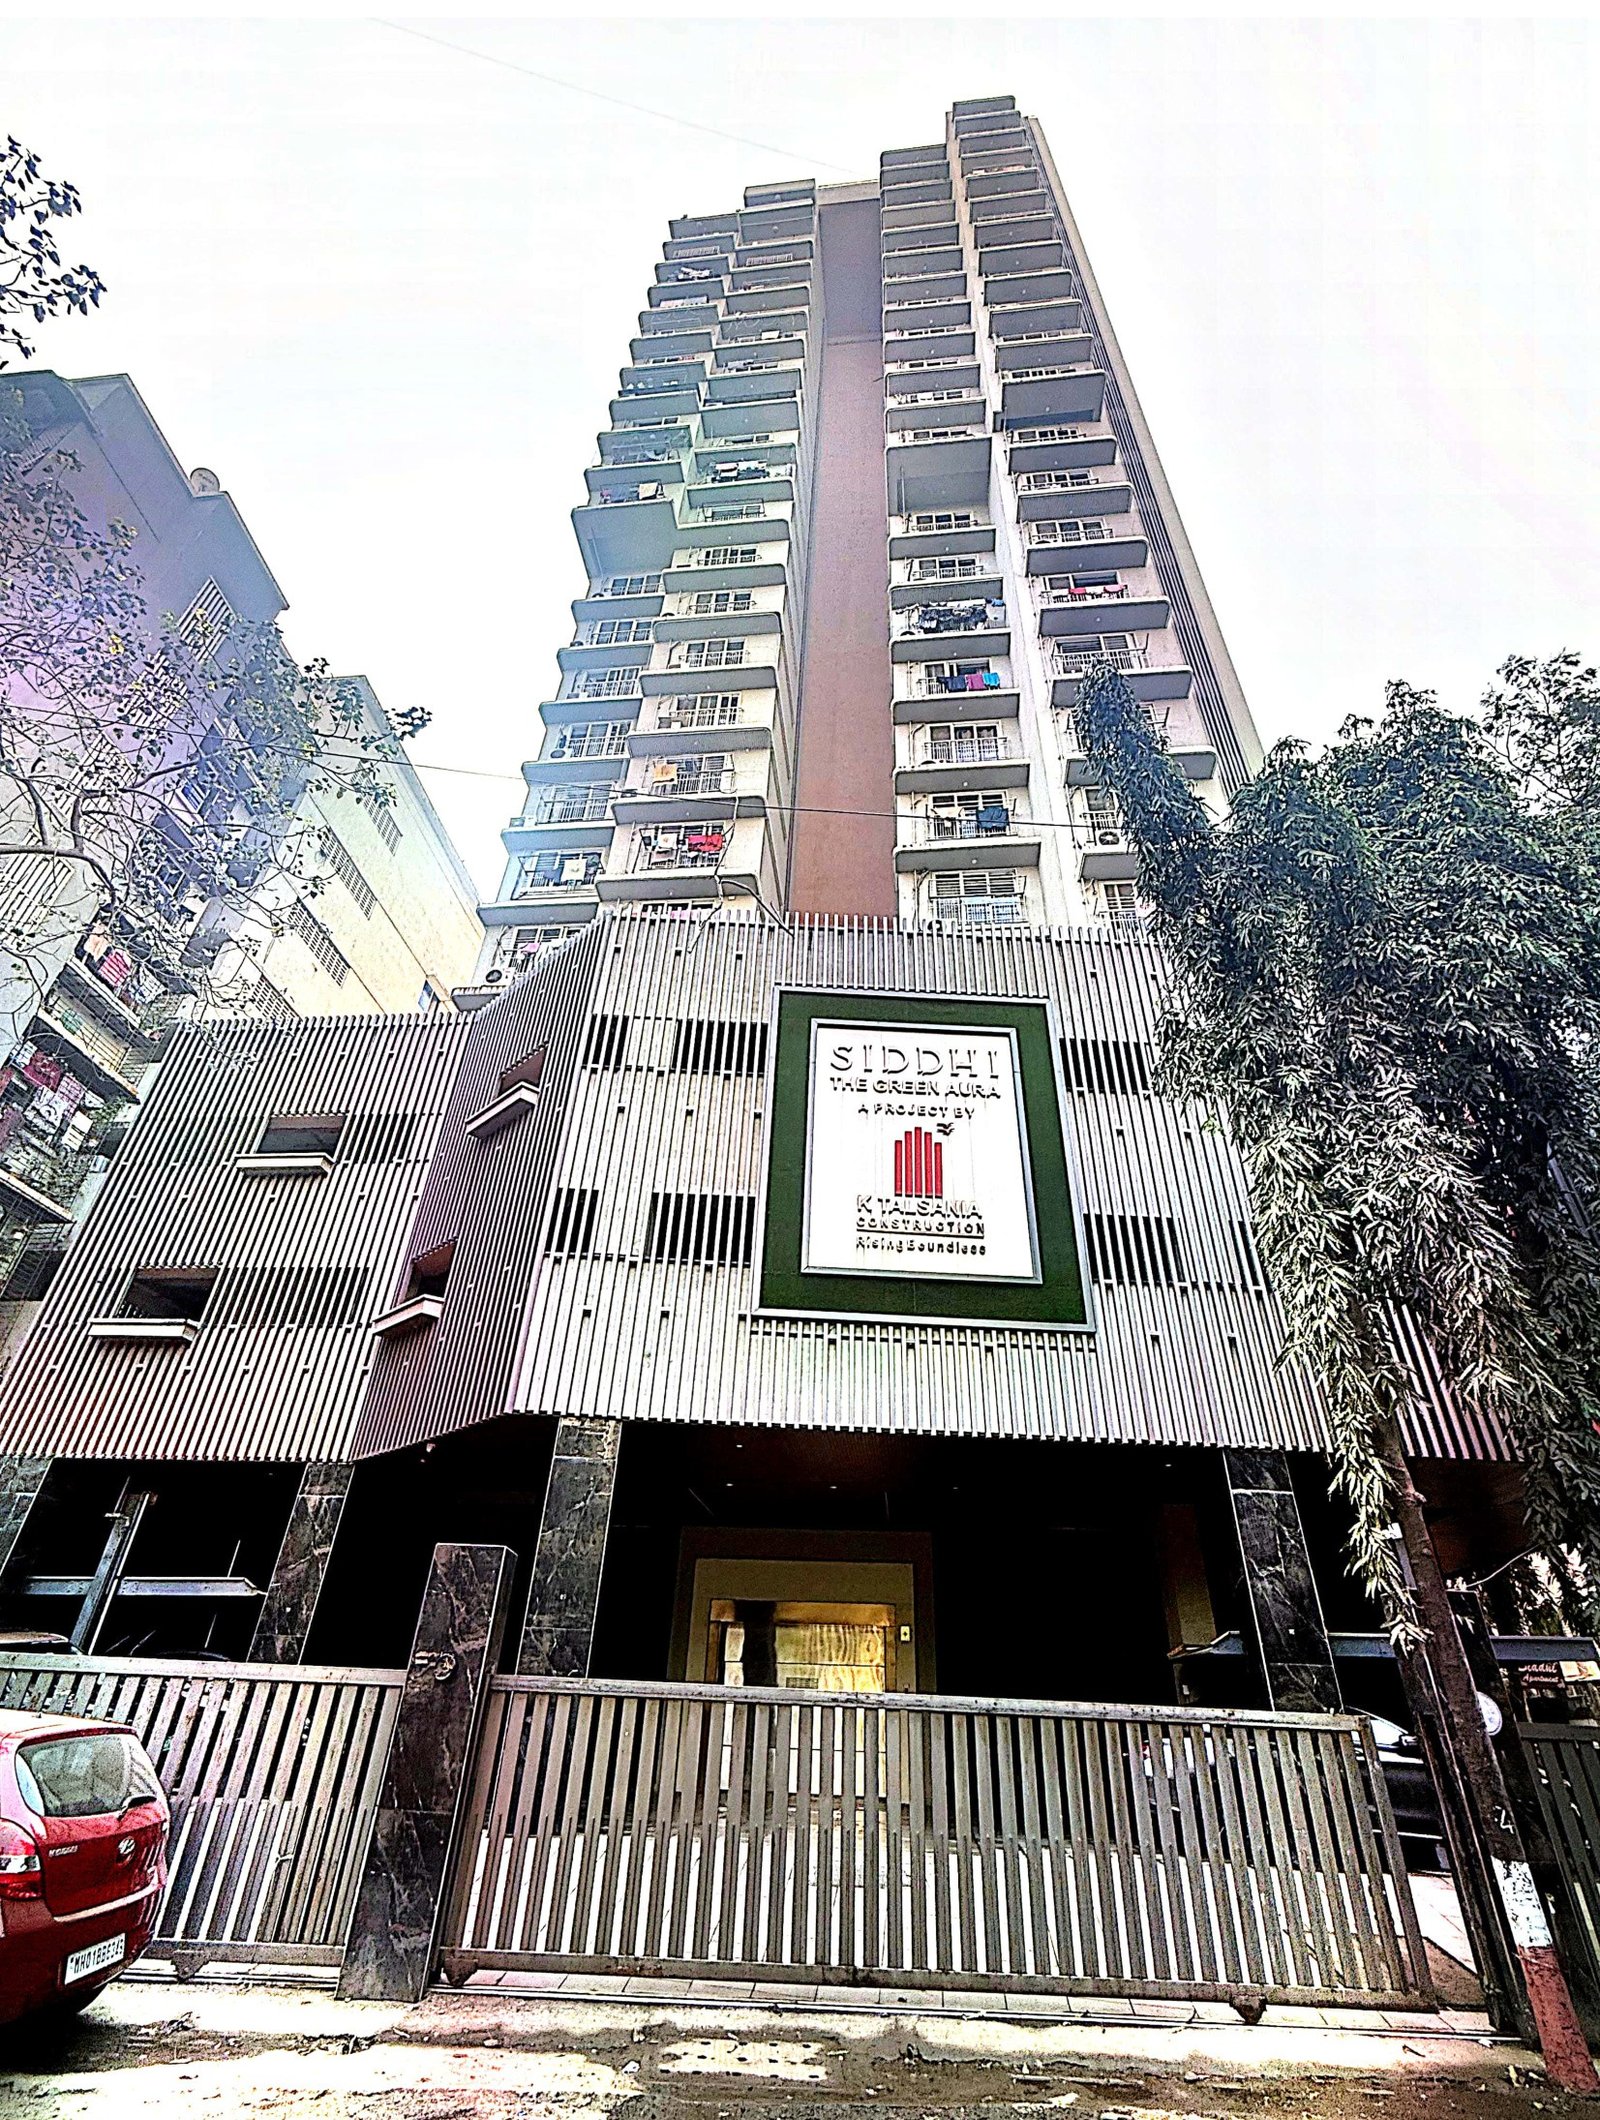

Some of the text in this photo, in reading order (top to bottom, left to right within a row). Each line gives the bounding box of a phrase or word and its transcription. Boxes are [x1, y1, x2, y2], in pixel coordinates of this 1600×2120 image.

[830, 1045, 999, 1080] SIDDHI
[830, 1077, 1001, 1099] THE GREEN AURA
[858, 1103, 975, 1120] A PROJECT BY
[857, 1194, 983, 1220] K TALSANIA
[856, 1217, 985, 1235] CONSTRUCTION
